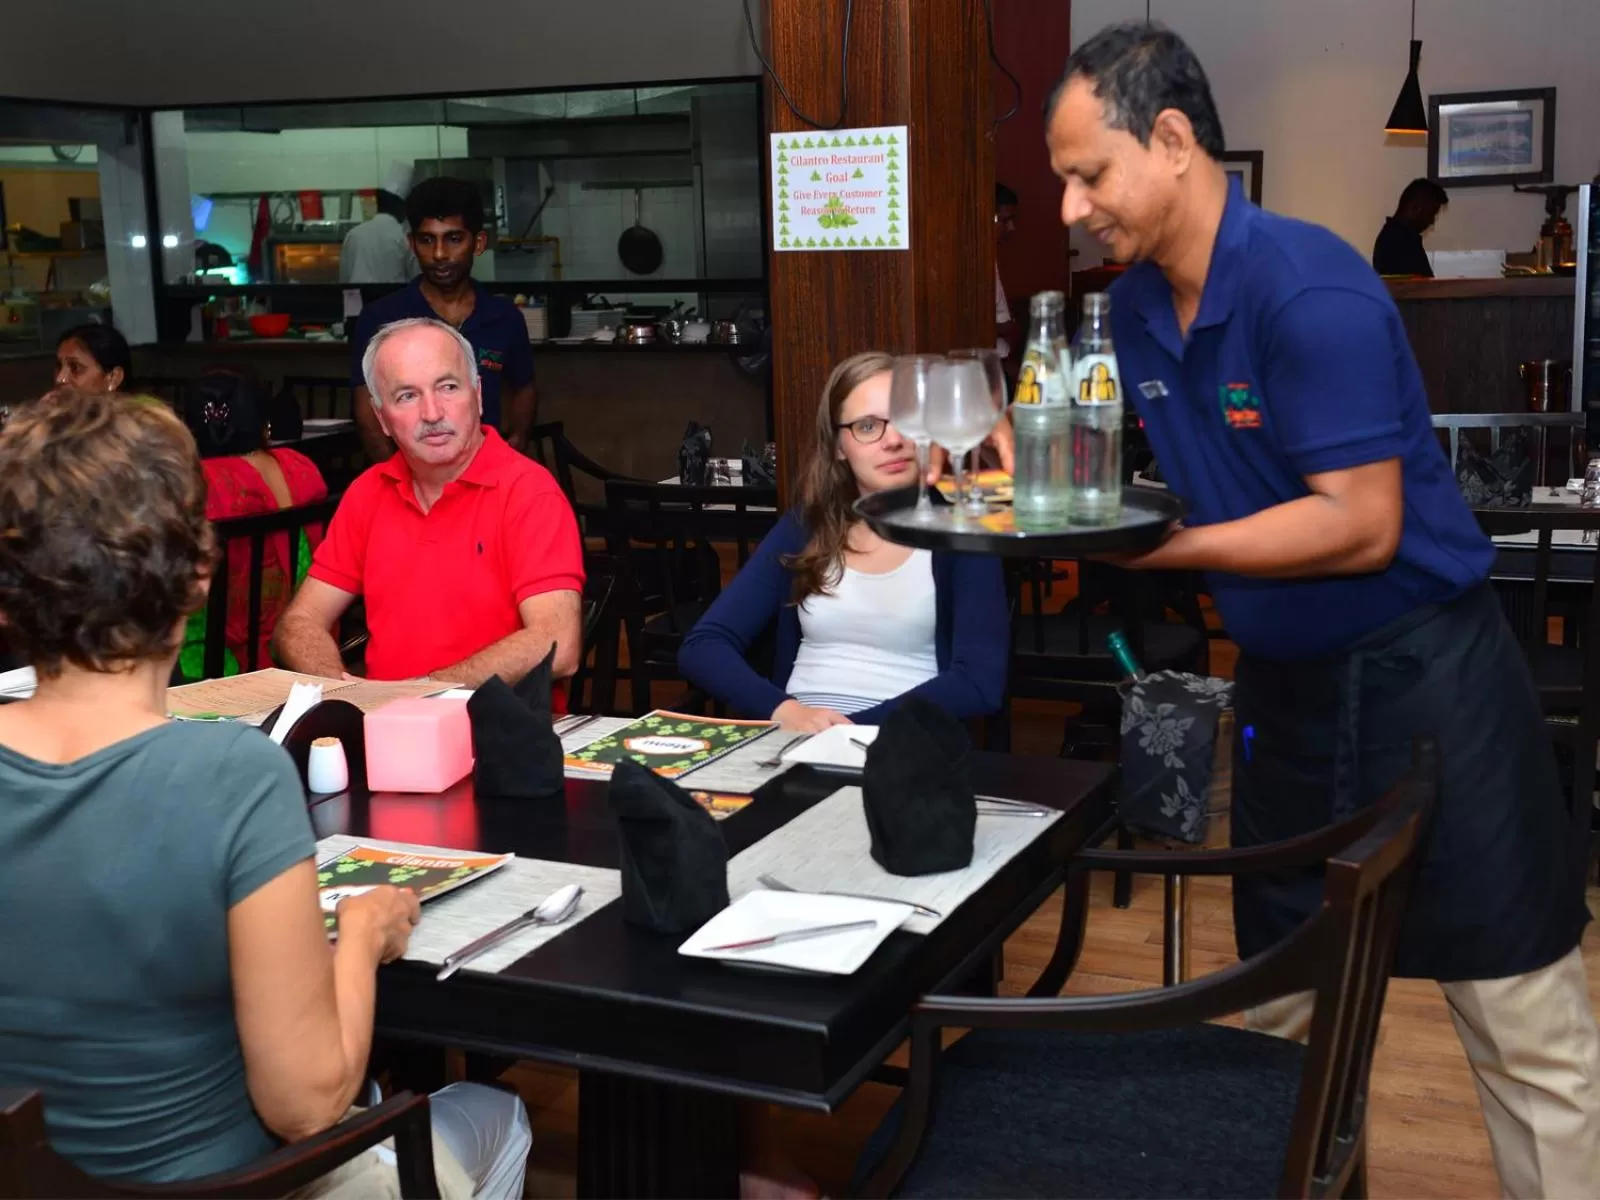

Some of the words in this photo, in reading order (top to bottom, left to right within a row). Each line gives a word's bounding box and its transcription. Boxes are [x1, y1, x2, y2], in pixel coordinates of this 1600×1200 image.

[790, 155, 829, 167] Cilantro
[831, 153, 885, 165] Restaurant
[825, 172, 848, 183] Goal
[793, 190, 812, 201] Give
[813, 190, 838, 201] Every
[839, 188, 884, 199] Customer
[844, 204, 876, 215] Return
